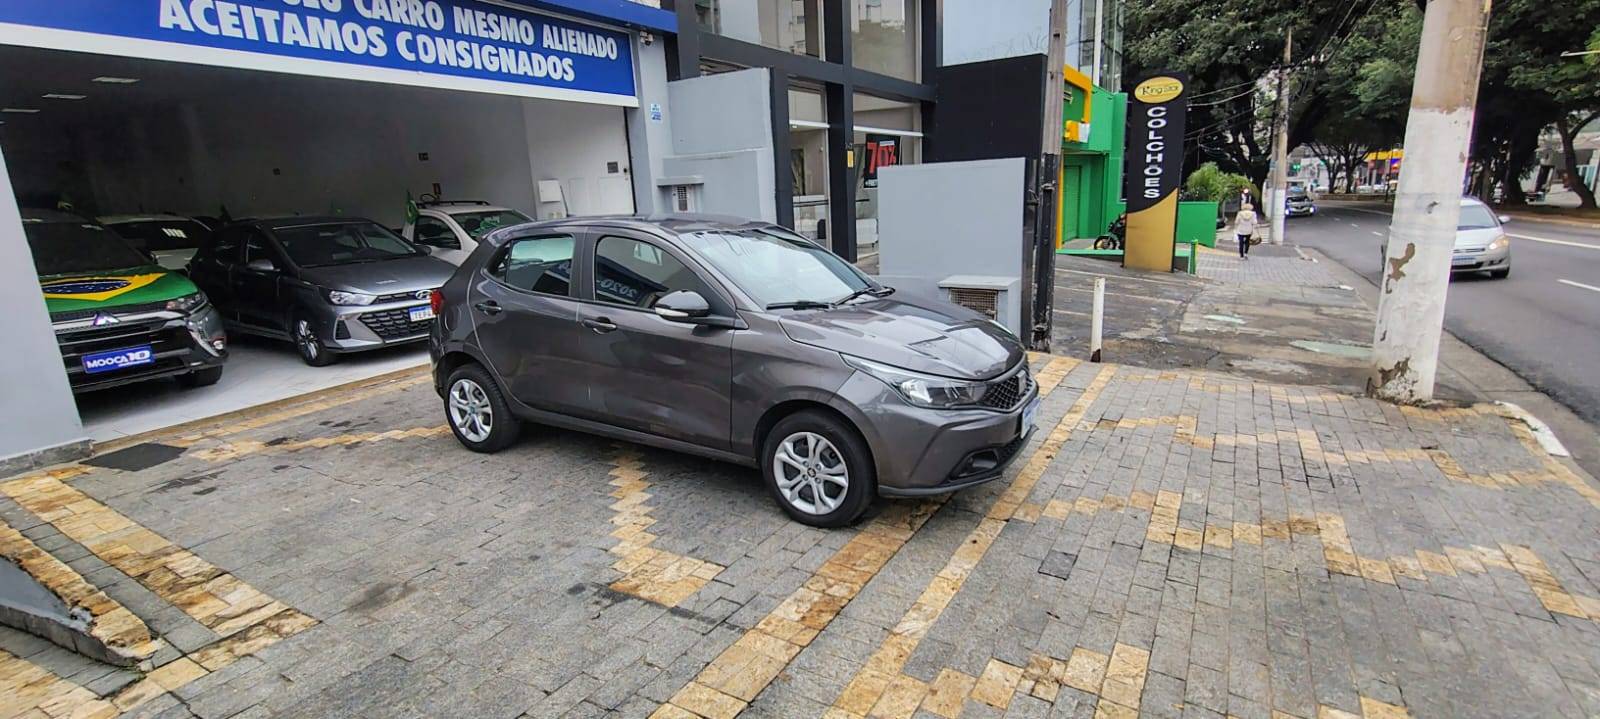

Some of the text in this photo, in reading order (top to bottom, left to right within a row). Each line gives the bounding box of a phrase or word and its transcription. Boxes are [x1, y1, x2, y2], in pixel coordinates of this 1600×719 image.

[159, 0, 575, 82] ACEITAMOS CONSIGNADOS
[353, 0, 618, 60] CARRO MESMO ALIENADO
[867, 142, 897, 174] 70%
[1143, 106, 1168, 198] COLCHÕES
